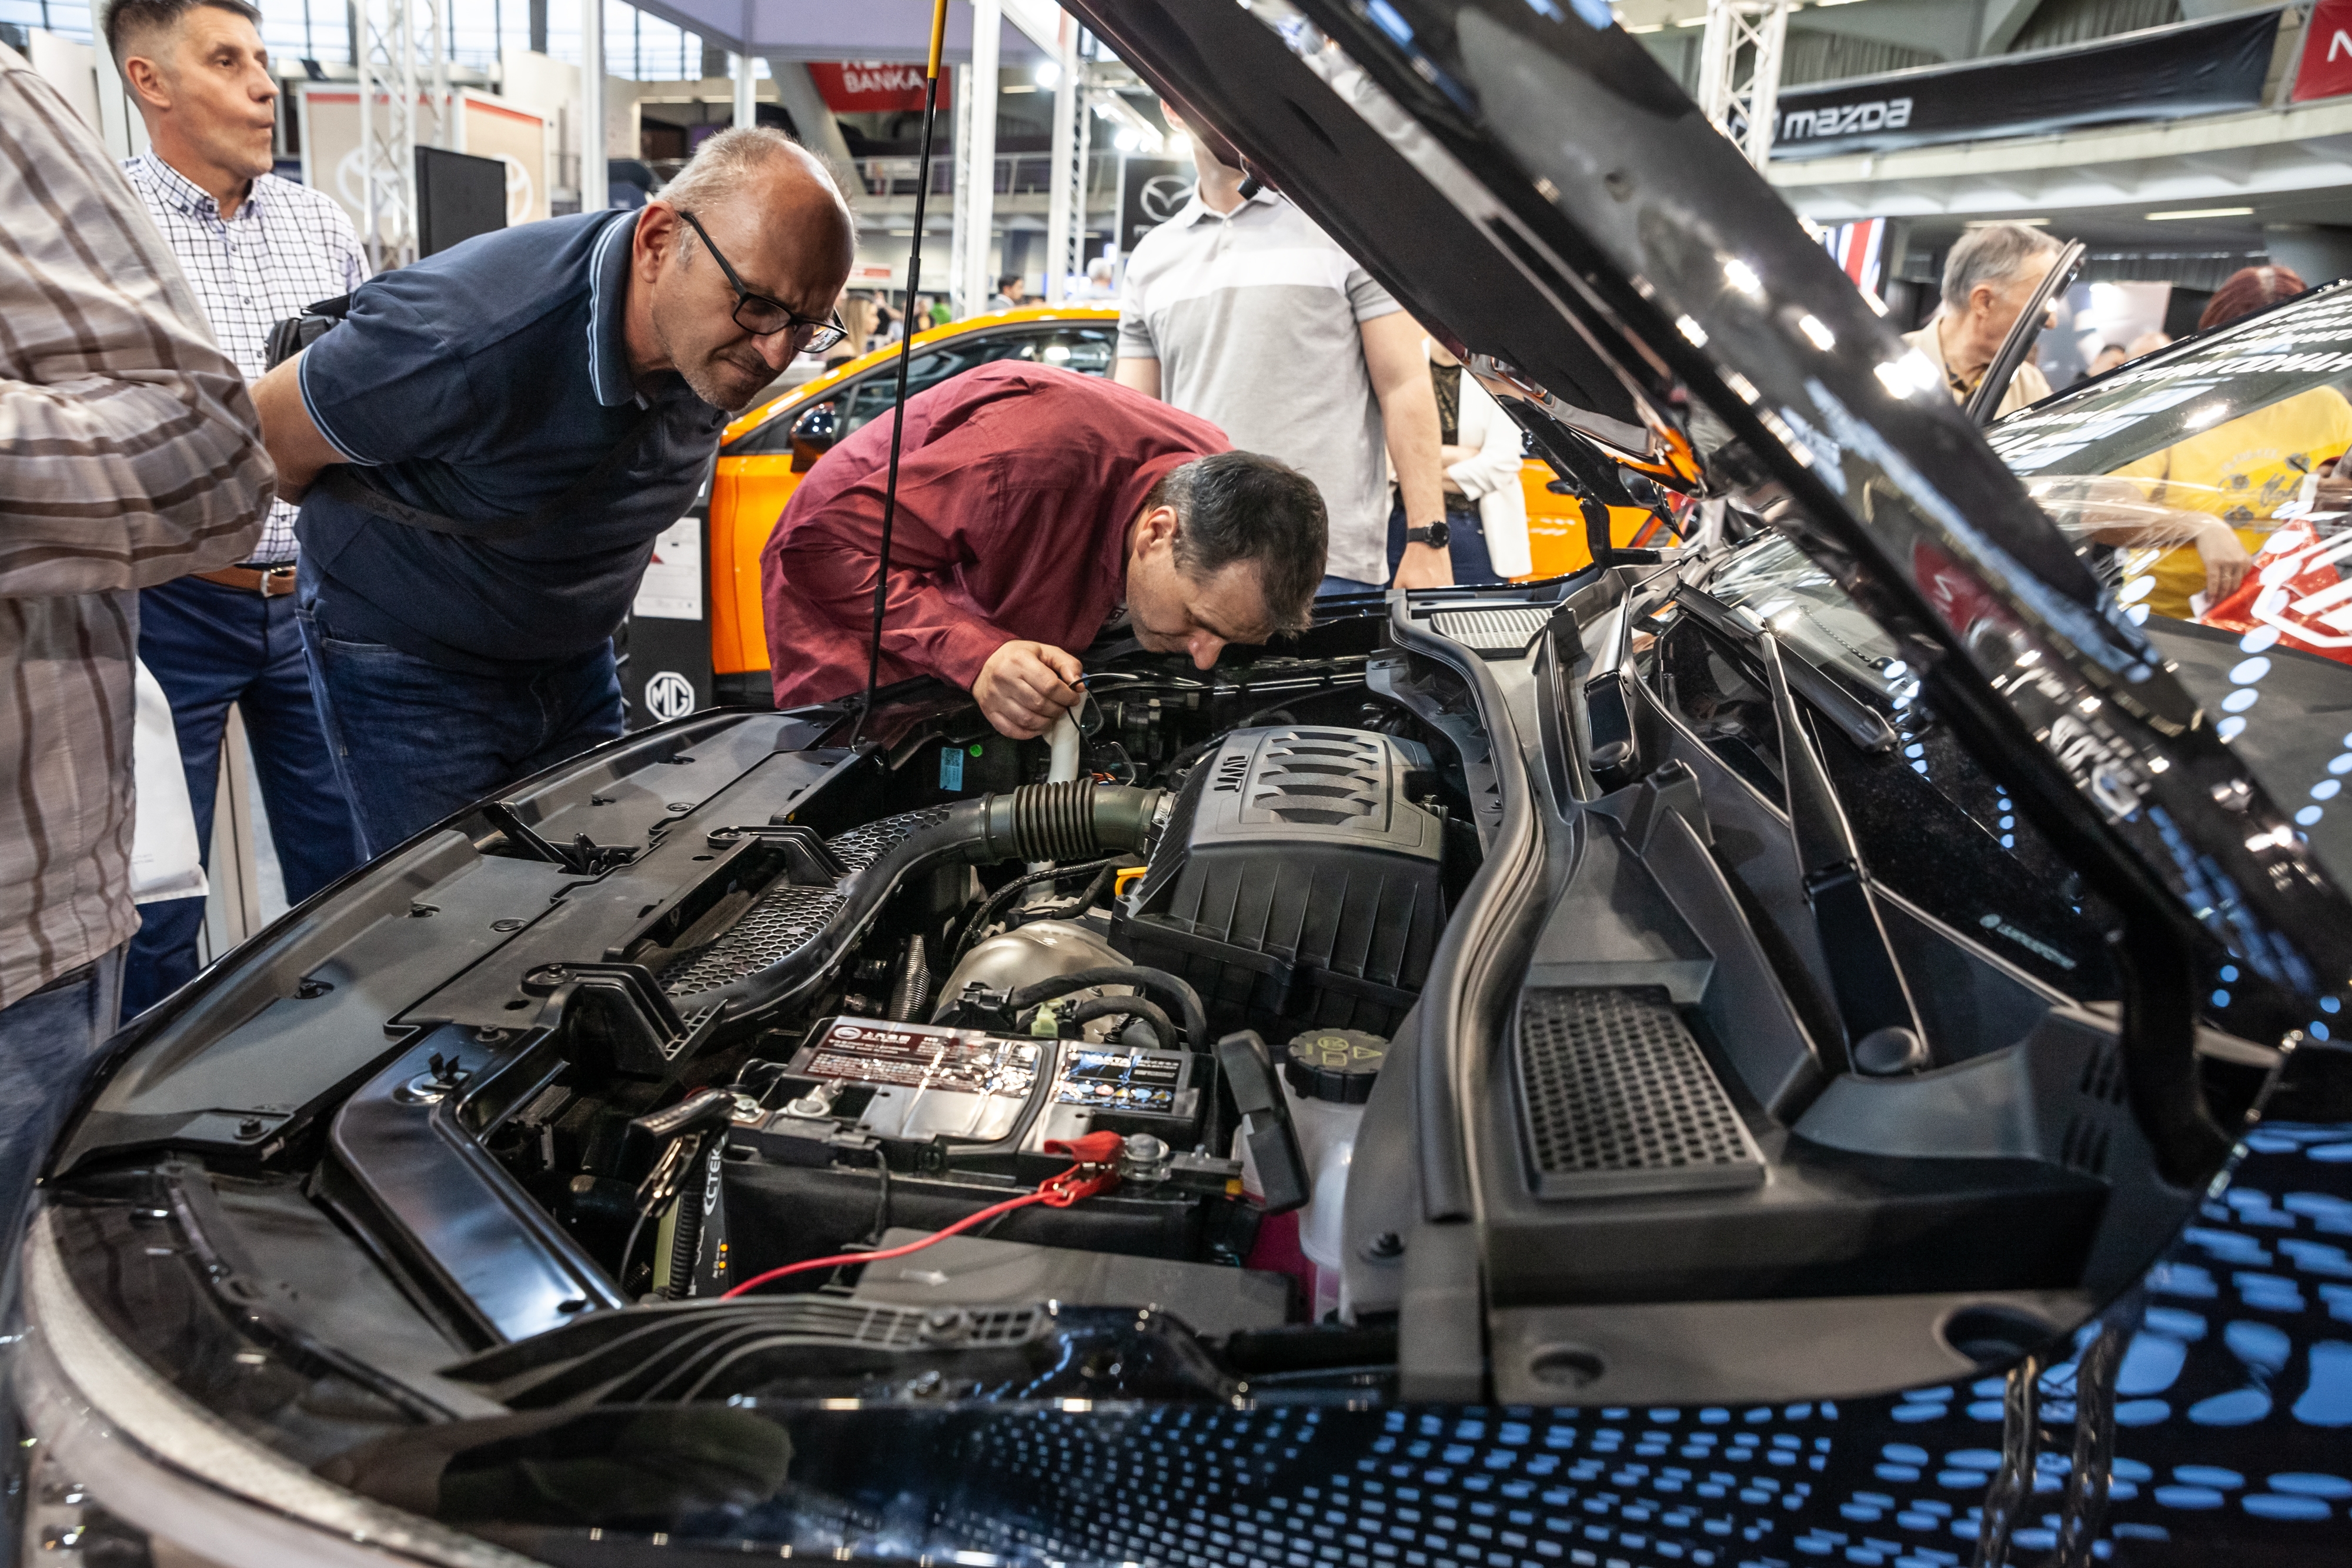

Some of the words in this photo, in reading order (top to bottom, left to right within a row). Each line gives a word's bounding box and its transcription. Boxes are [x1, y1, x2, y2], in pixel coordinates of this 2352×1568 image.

[842, 68, 926, 93] BANKA
[1782, 96, 1914, 141] mazda
[654, 677, 690, 717] MG
[705, 1148, 723, 1199] CTEK
